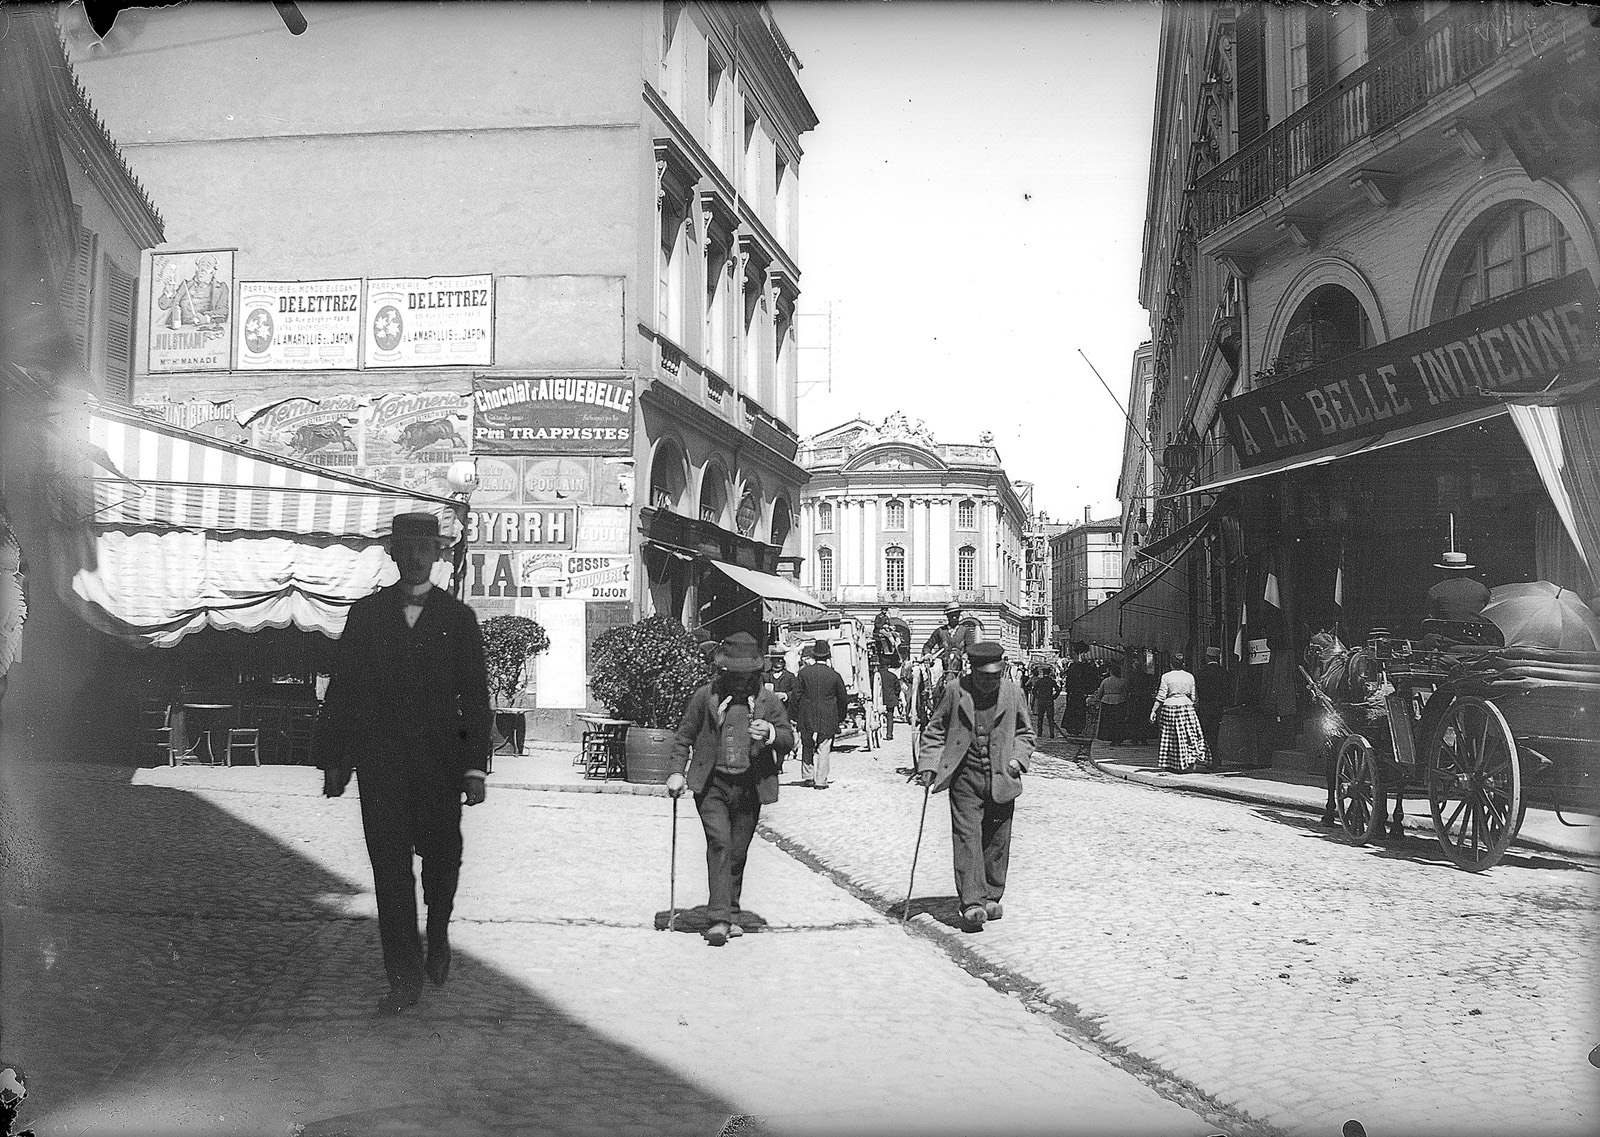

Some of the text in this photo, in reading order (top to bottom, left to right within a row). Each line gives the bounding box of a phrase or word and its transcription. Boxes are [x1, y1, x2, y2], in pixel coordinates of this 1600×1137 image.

[278, 295, 358, 313] DELETTREZ
[407, 289, 488, 310] DELETTREZ
[330, 332, 354, 345] JAPON
[462, 327, 486, 342] JAPON
[181, 356, 218, 365] MANADE
[1238, 302, 1593, 457] A LA BELLE INDIENNE
[474, 379, 531, 412] Chocolat
[260, 396, 359, 429] Kemmerich
[365, 394, 468, 428] Kemmerich
[509, 427, 630, 440] TRAPPISTES
[530, 477, 585, 493] POULAIN
[592, 587, 628, 598] DIJON
